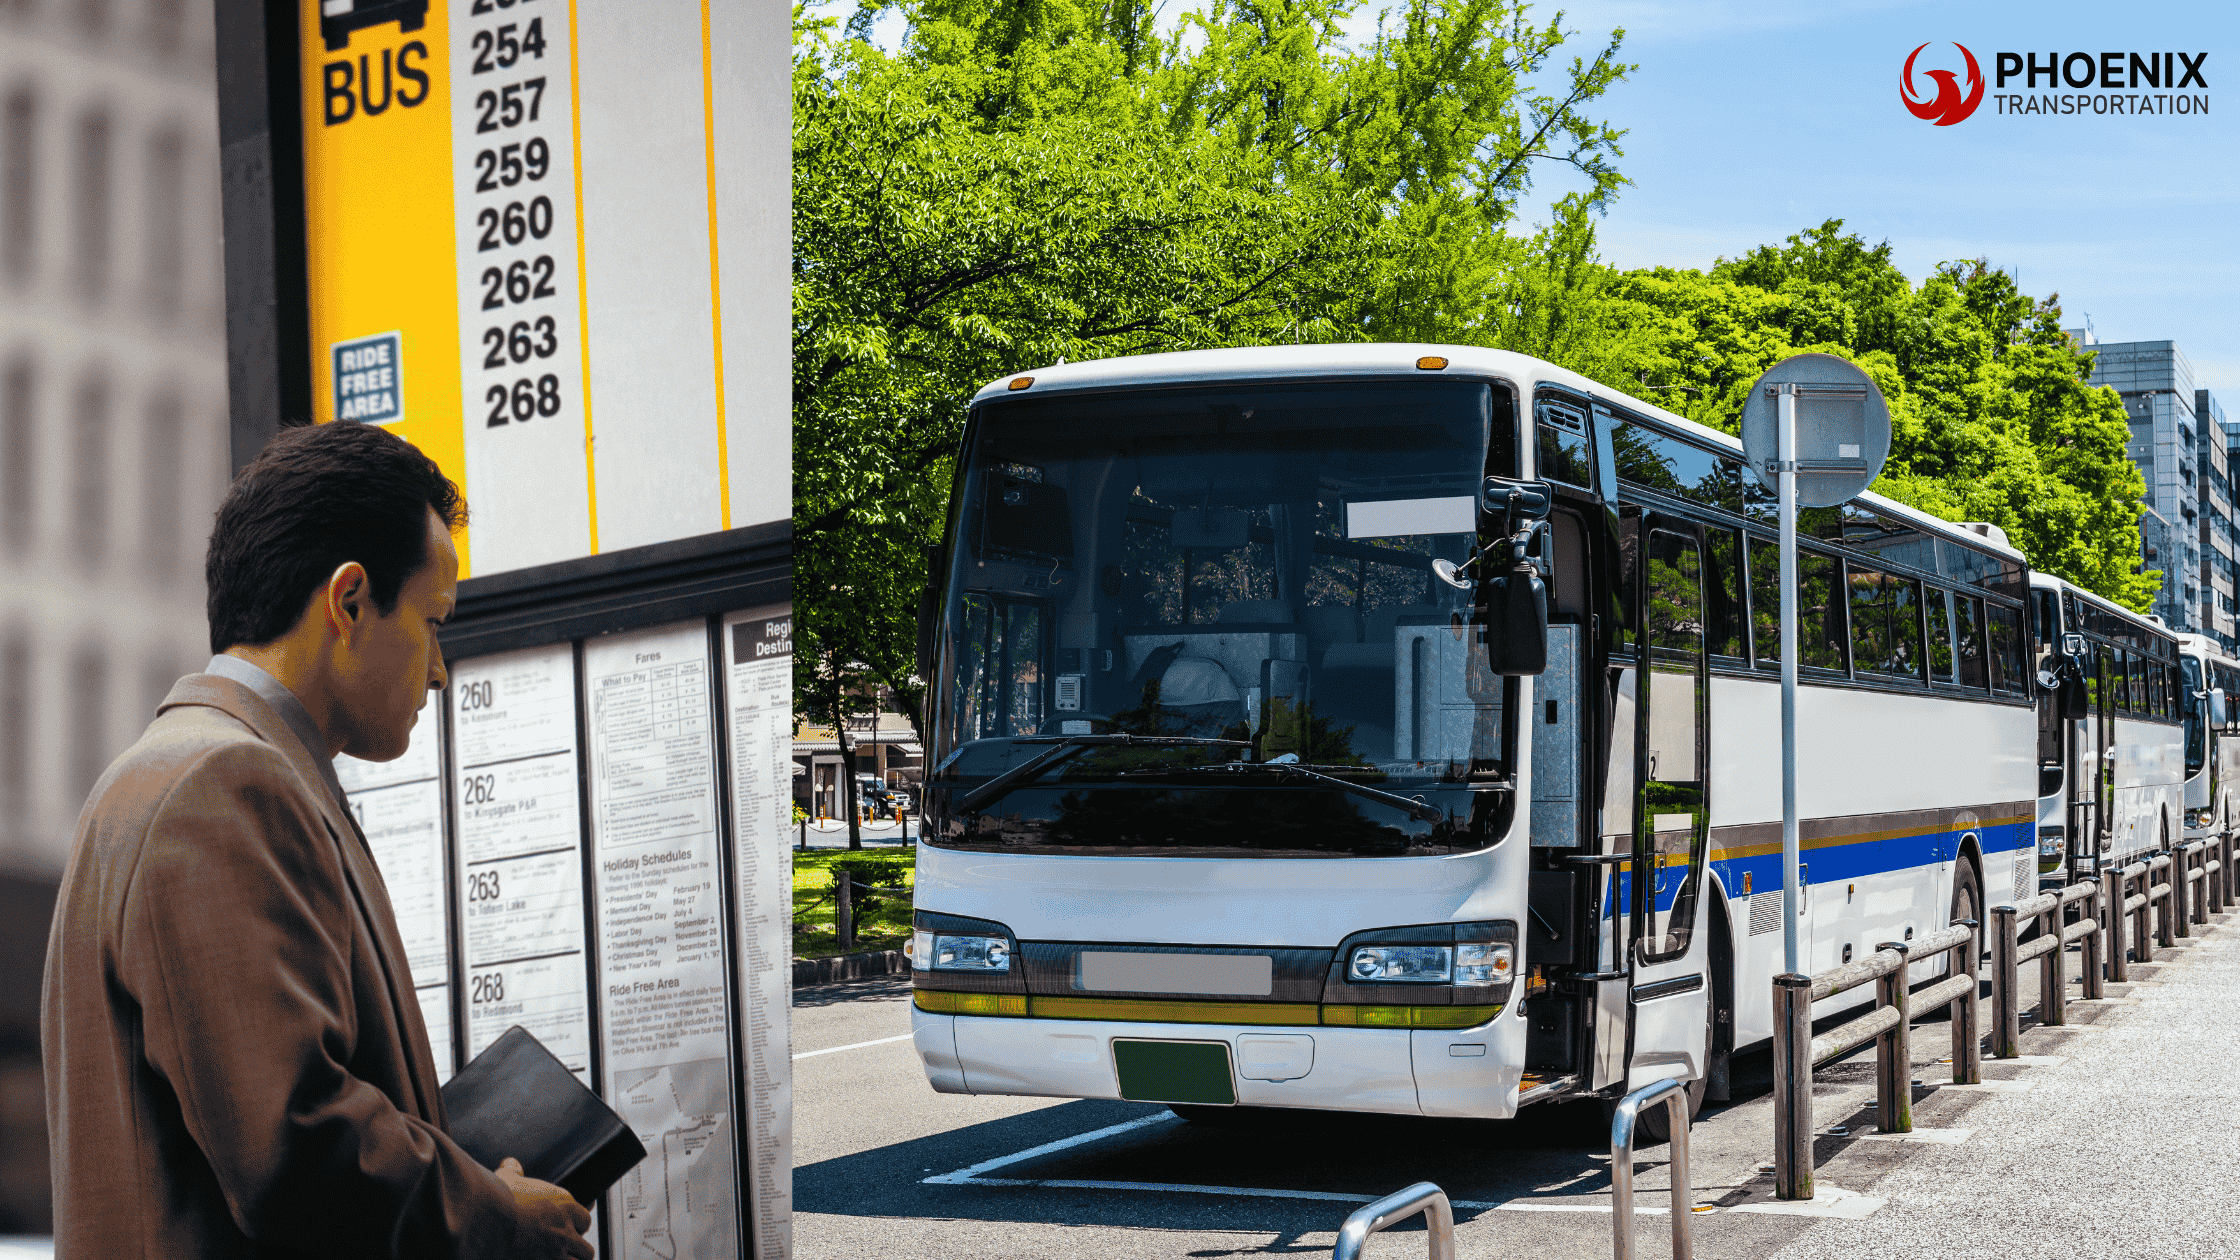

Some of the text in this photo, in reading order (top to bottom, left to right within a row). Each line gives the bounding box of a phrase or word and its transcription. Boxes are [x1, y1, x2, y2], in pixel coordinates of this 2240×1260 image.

[472, 17, 547, 75] 254
[324, 40, 429, 126] BUS
[476, 76, 547, 135] 257
[476, 136, 550, 194] 259
[478, 195, 553, 253] 260
[481, 254, 556, 312] 262
[483, 315, 558, 371] 263
[341, 343, 391, 372] RIDE
[341, 366, 393, 396] FREE
[341, 391, 395, 420] AREA
[486, 373, 561, 429] 268
[766, 618, 792, 638] Regi
[756, 638, 792, 656] Destin
[636, 652, 661, 664] Fares
[602, 678, 621, 688] What
[633, 673, 646, 682] Pay
[460, 680, 493, 712] 260
[464, 774, 496, 806] 262
[603, 850, 692, 872] Holiday Schedules
[468, 870, 500, 902] 263
[646, 890, 657, 899] Day
[673, 881, 711, 894] February 19
[610, 903, 651, 915] Memorial Day
[673, 896, 695, 906] May 27
[610, 912, 667, 927] Independence Day
[674, 909, 687, 918] July
[674, 916, 715, 929] September 2
[611, 928, 642, 938] Labor Day
[676, 930, 708, 940] November
[612, 936, 667, 950] Thanksgiving Day
[676, 939, 717, 952] December 25
[612, 949, 658, 961] Christmas Day
[677, 953, 702, 963] January
[613, 964, 626, 972] New
[649, 960, 661, 968] Day
[471, 972, 504, 1005] 268
[609, 978, 680, 997] Ride Free Area
